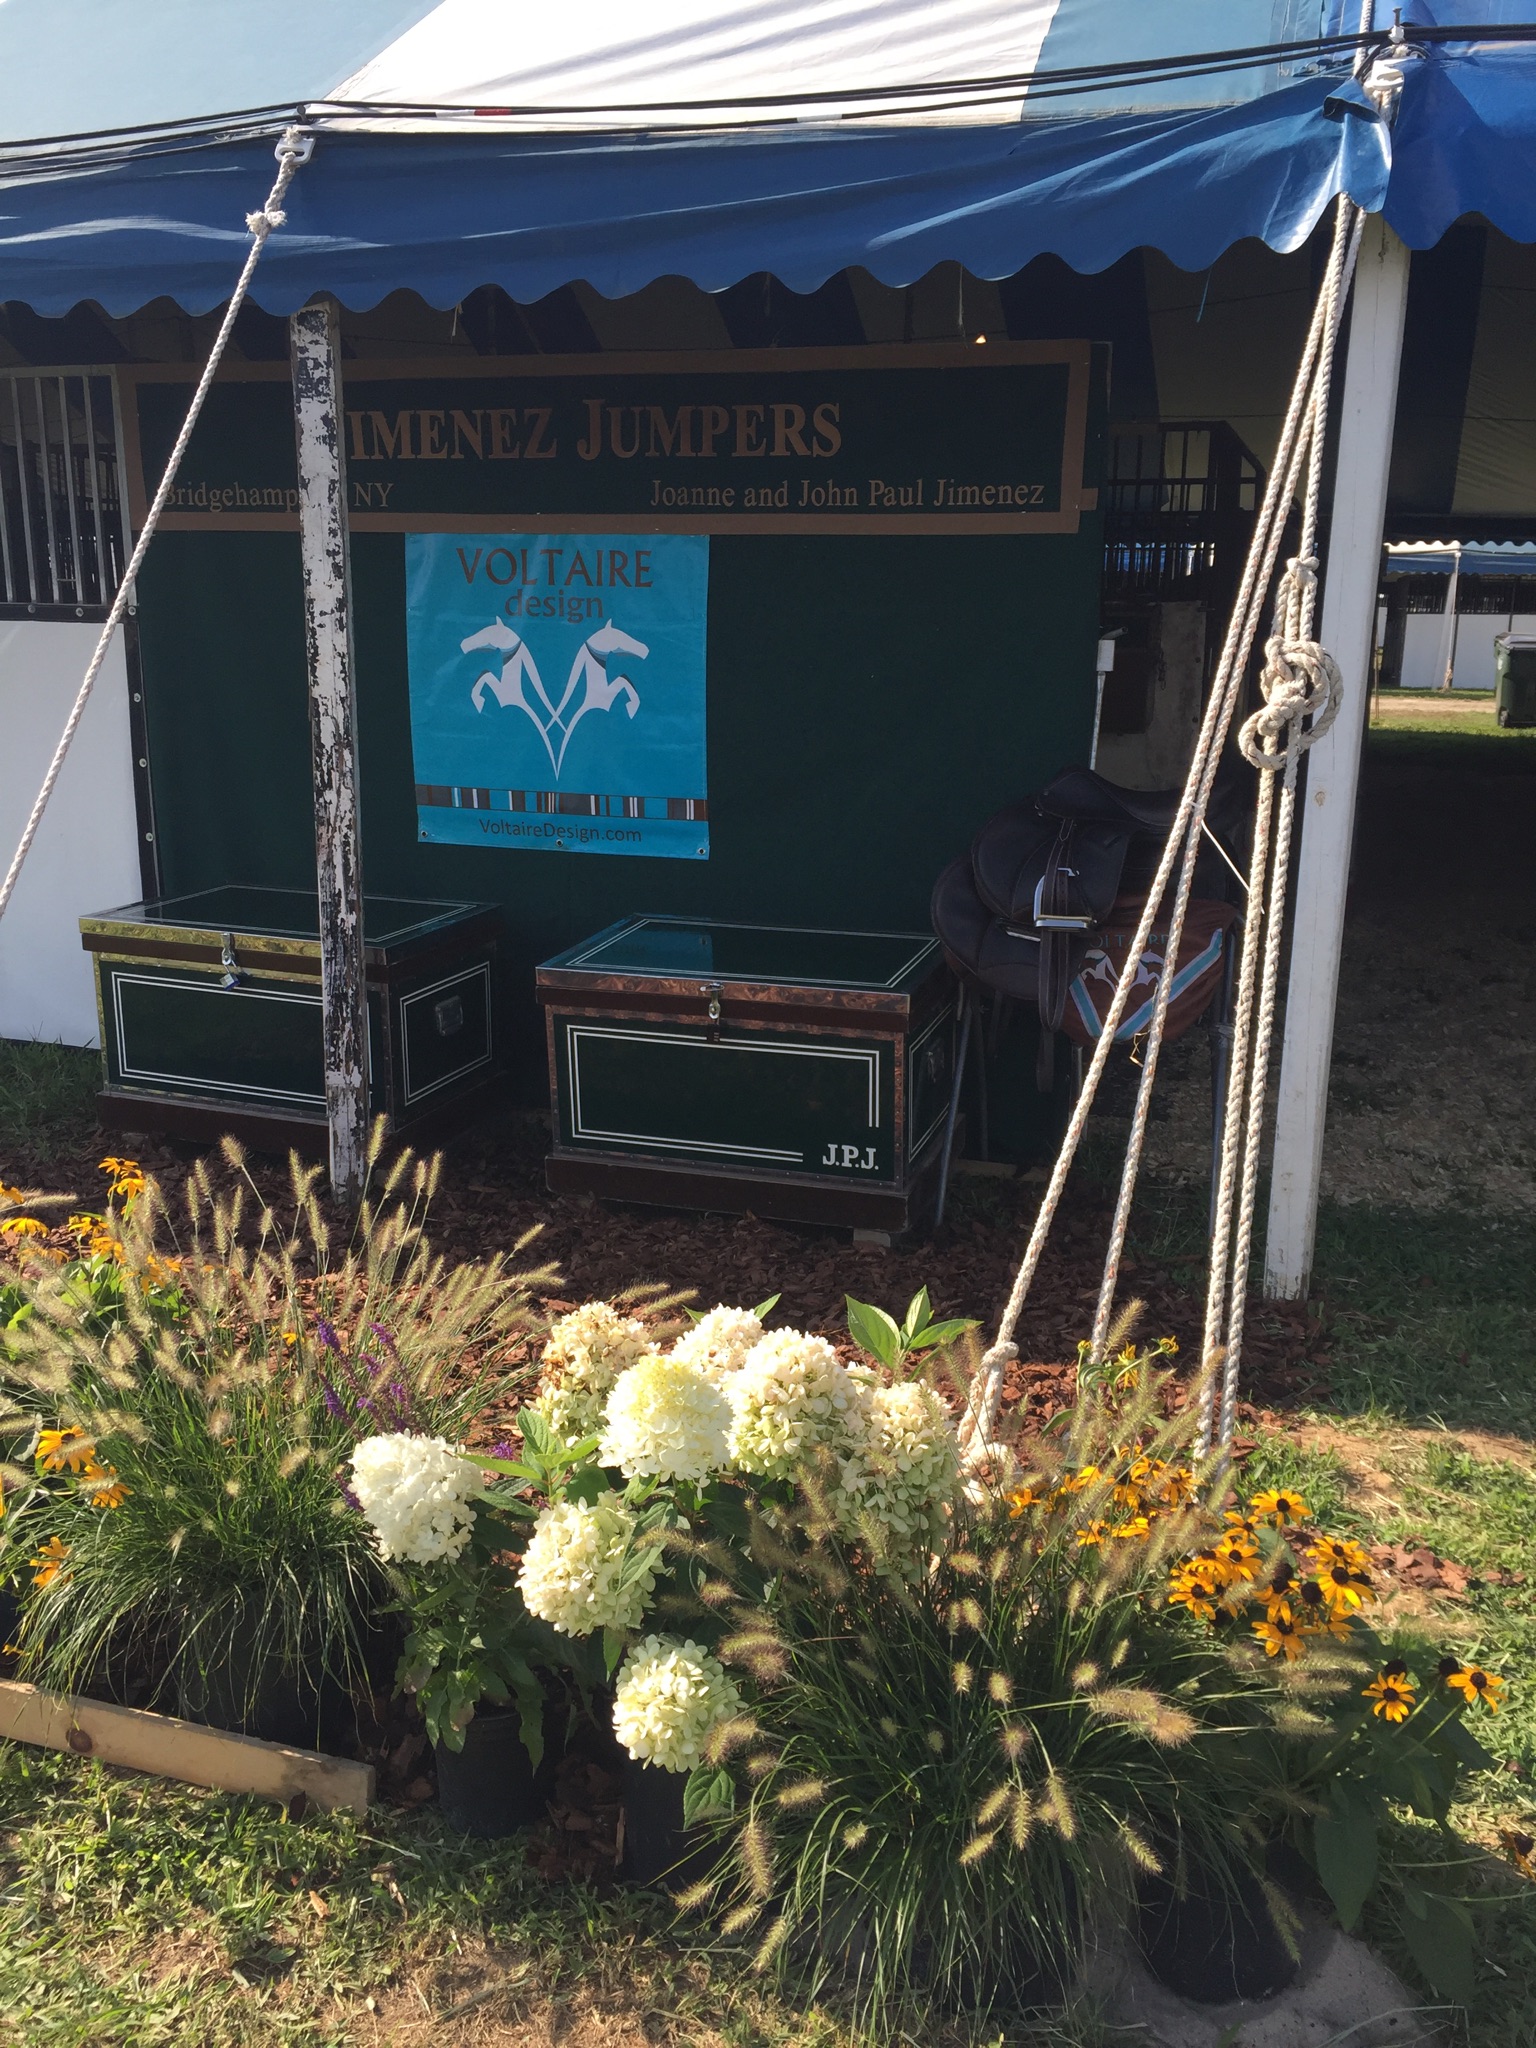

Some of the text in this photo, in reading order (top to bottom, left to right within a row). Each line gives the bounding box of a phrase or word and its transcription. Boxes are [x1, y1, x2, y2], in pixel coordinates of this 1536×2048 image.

[345, 399, 842, 460] IMENEZ JUMPERS
[164, 481, 394, 513] Bridgehamp NY
[650, 478, 1045, 507] Joanne and John Paul Jimenez
[456, 547, 654, 588] VOLTAIRE
[504, 588, 604, 624] design
[478, 818, 643, 843] VoltaireDesign.com
